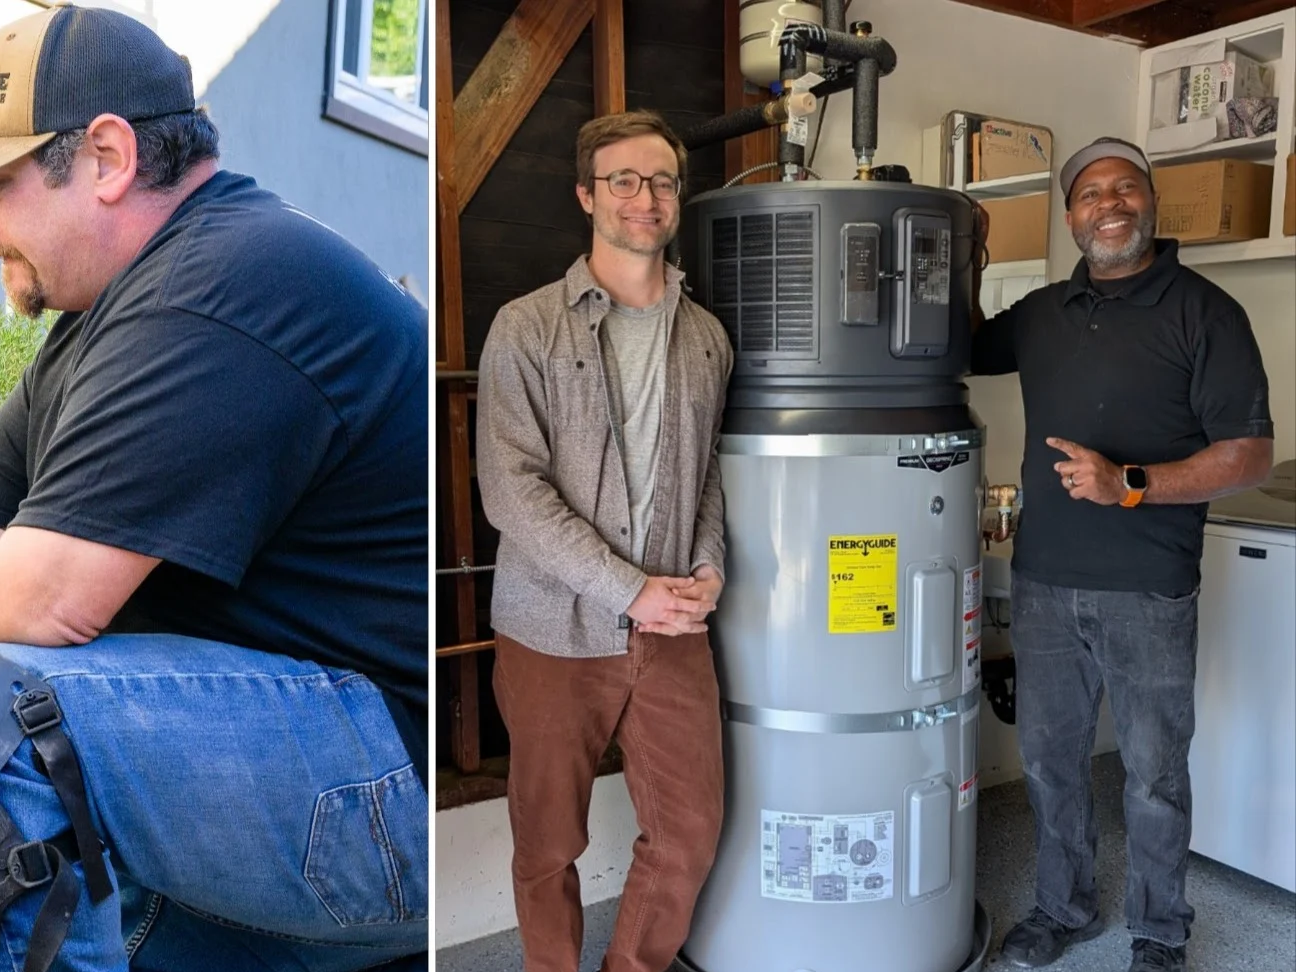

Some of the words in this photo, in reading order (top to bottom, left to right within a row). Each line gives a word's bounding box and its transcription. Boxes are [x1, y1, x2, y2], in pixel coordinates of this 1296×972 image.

[1192, 74, 1202, 111] water
[829, 538, 897, 551] ENERGYGUIDE
[831, 572, 855, 581] $162
